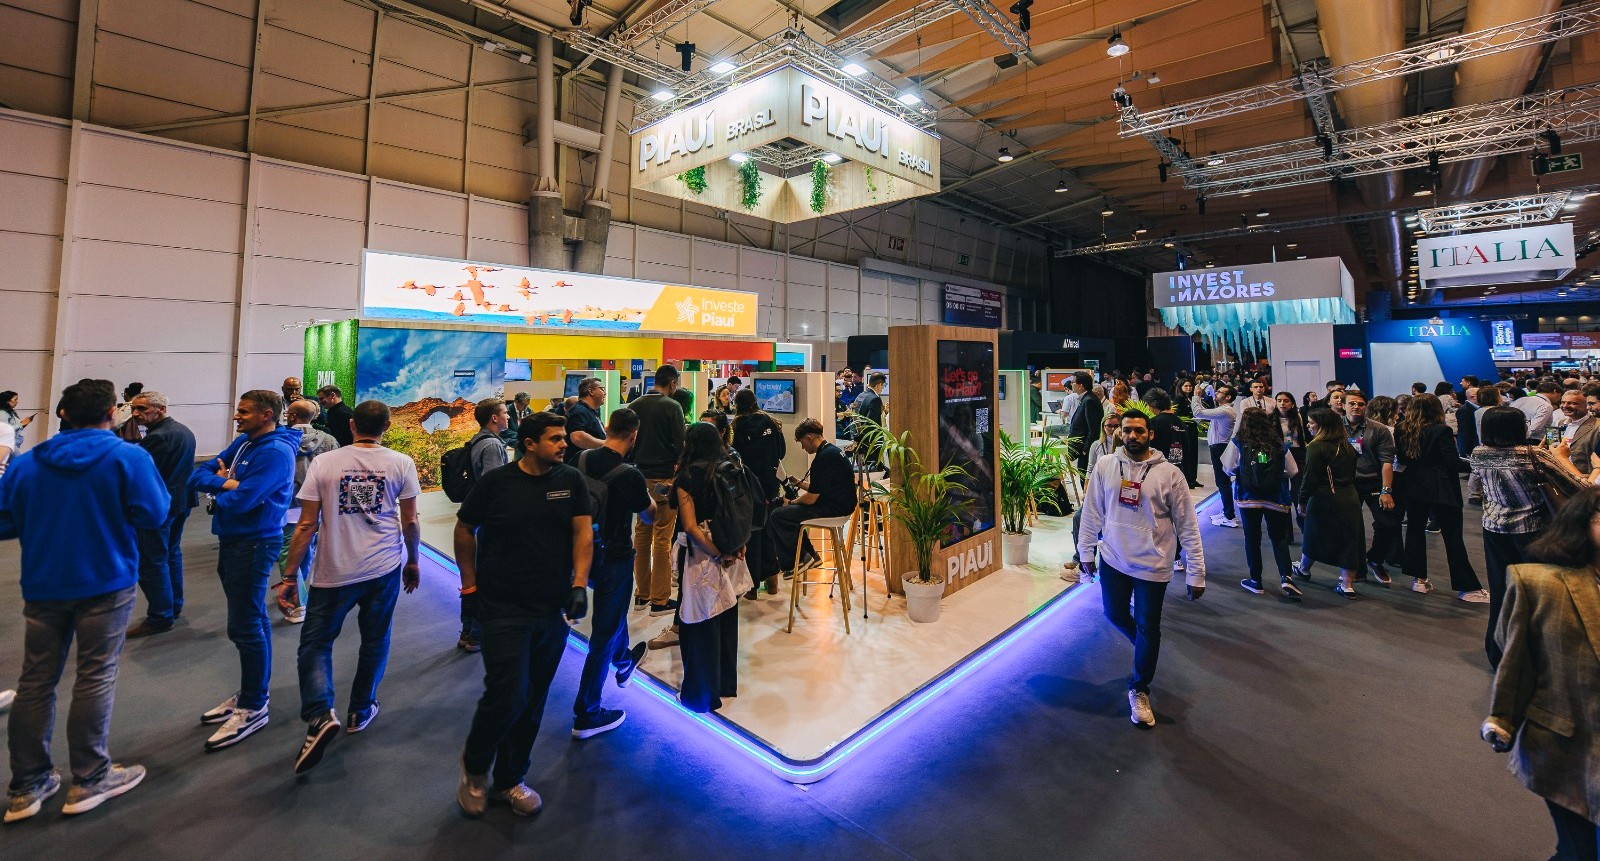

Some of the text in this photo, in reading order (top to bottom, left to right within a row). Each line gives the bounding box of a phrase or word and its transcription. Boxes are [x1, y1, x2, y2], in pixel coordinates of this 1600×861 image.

[640, 108, 715, 172] PIAUÍ
[801, 83, 934, 178] PIAUÍ BRASIL
[1429, 237, 1564, 268] ITALIA
[1169, 270, 1244, 289] INVEST
[702, 297, 745, 313] Investe
[702, 312, 736, 328] Piauí
[1408, 325, 1471, 337] ITALIA
[967, 371, 979, 385] go
[947, 540, 993, 585] PIAUÍ
